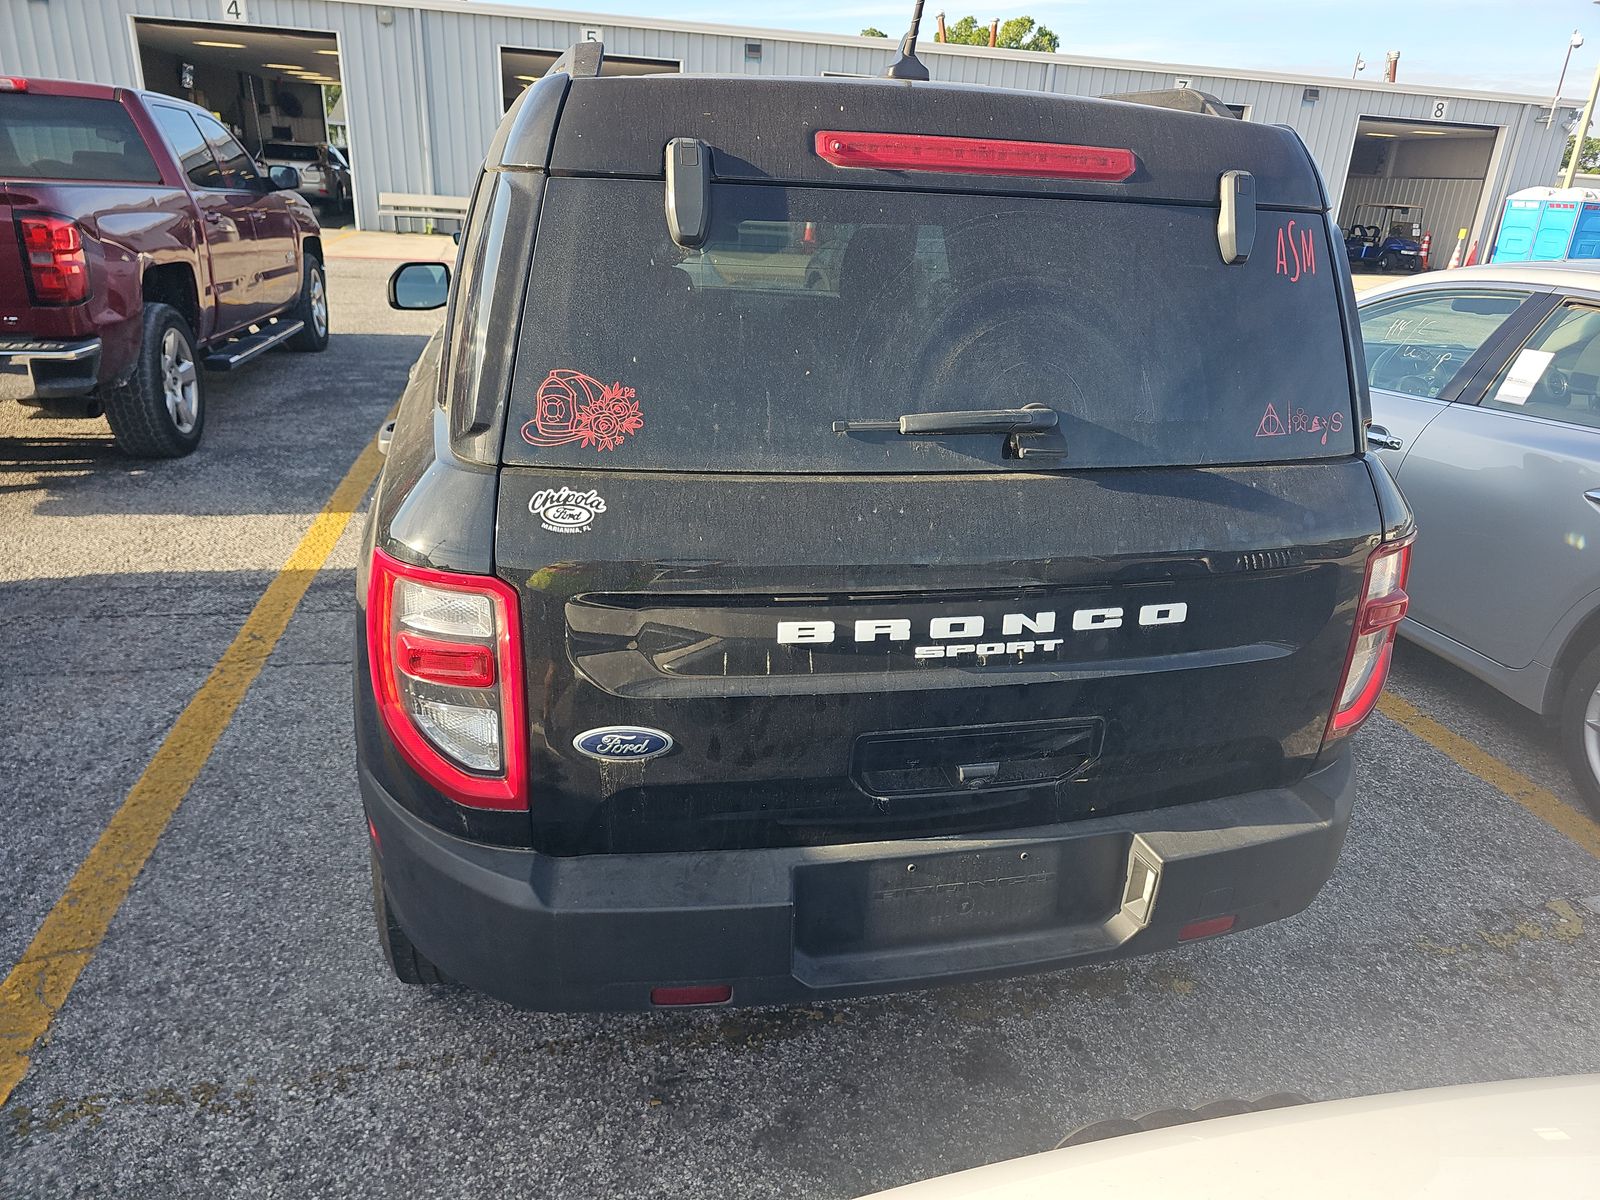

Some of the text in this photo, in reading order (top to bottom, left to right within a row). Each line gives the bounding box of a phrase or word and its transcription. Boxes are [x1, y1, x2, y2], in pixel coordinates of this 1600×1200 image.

[227, 0, 241, 19] 4
[587, 31, 597, 42] 5
[1434, 103, 1445, 118] 8
[1276, 220, 1316, 282] ASM
[529, 487, 606, 512] Chipola
[552, 507, 582, 521] Ford
[583, 524, 592, 532] FL
[777, 602, 1188, 644] BRONCO
[914, 638, 1064, 659] SPORT
[596, 734, 650, 754] Ford
